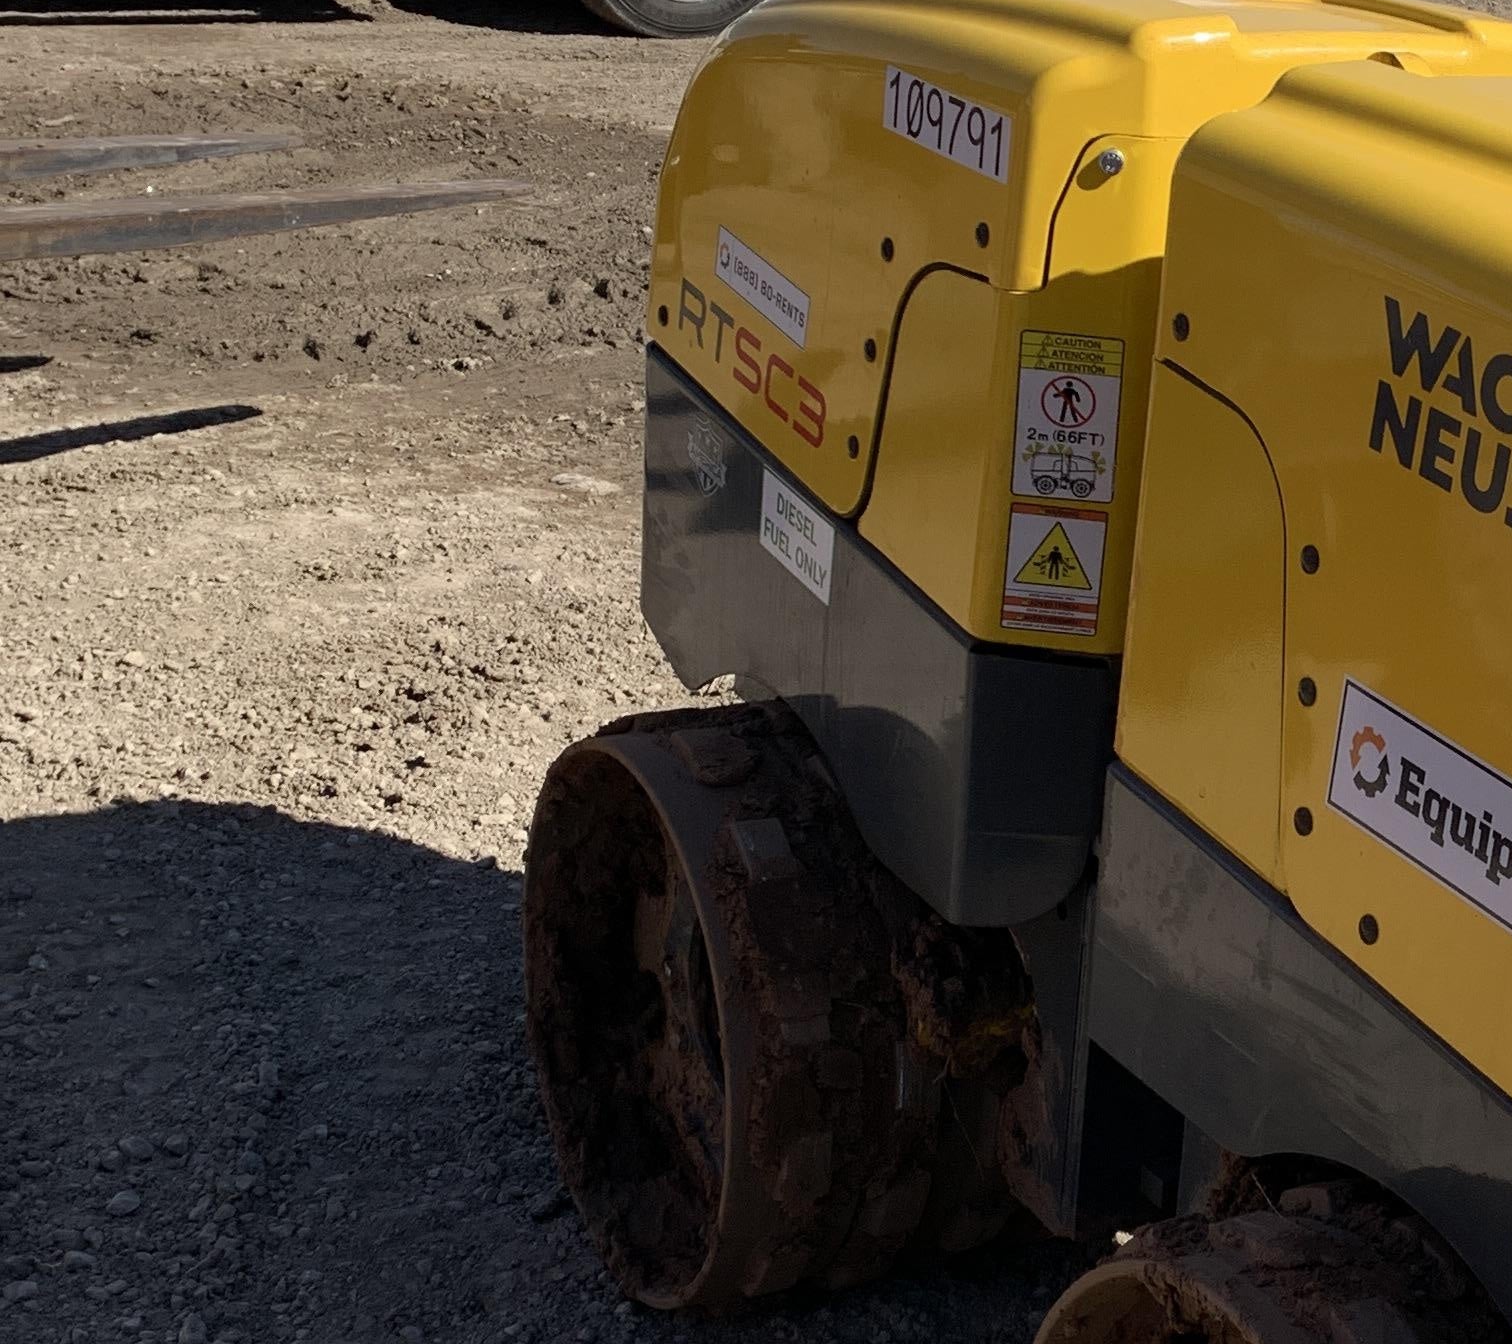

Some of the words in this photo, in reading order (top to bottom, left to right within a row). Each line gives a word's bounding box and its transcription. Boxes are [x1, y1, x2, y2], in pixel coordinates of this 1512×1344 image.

[733, 256, 759, 291] (888)
[760, 279, 806, 328] 80-RENTS
[678, 277, 827, 449] RTSC3
[1054, 337, 1102, 350] CAUTION
[763, 516, 792, 560] FUEL
[795, 545, 828, 589] ONLY
[776, 492, 817, 547] DIESEL
